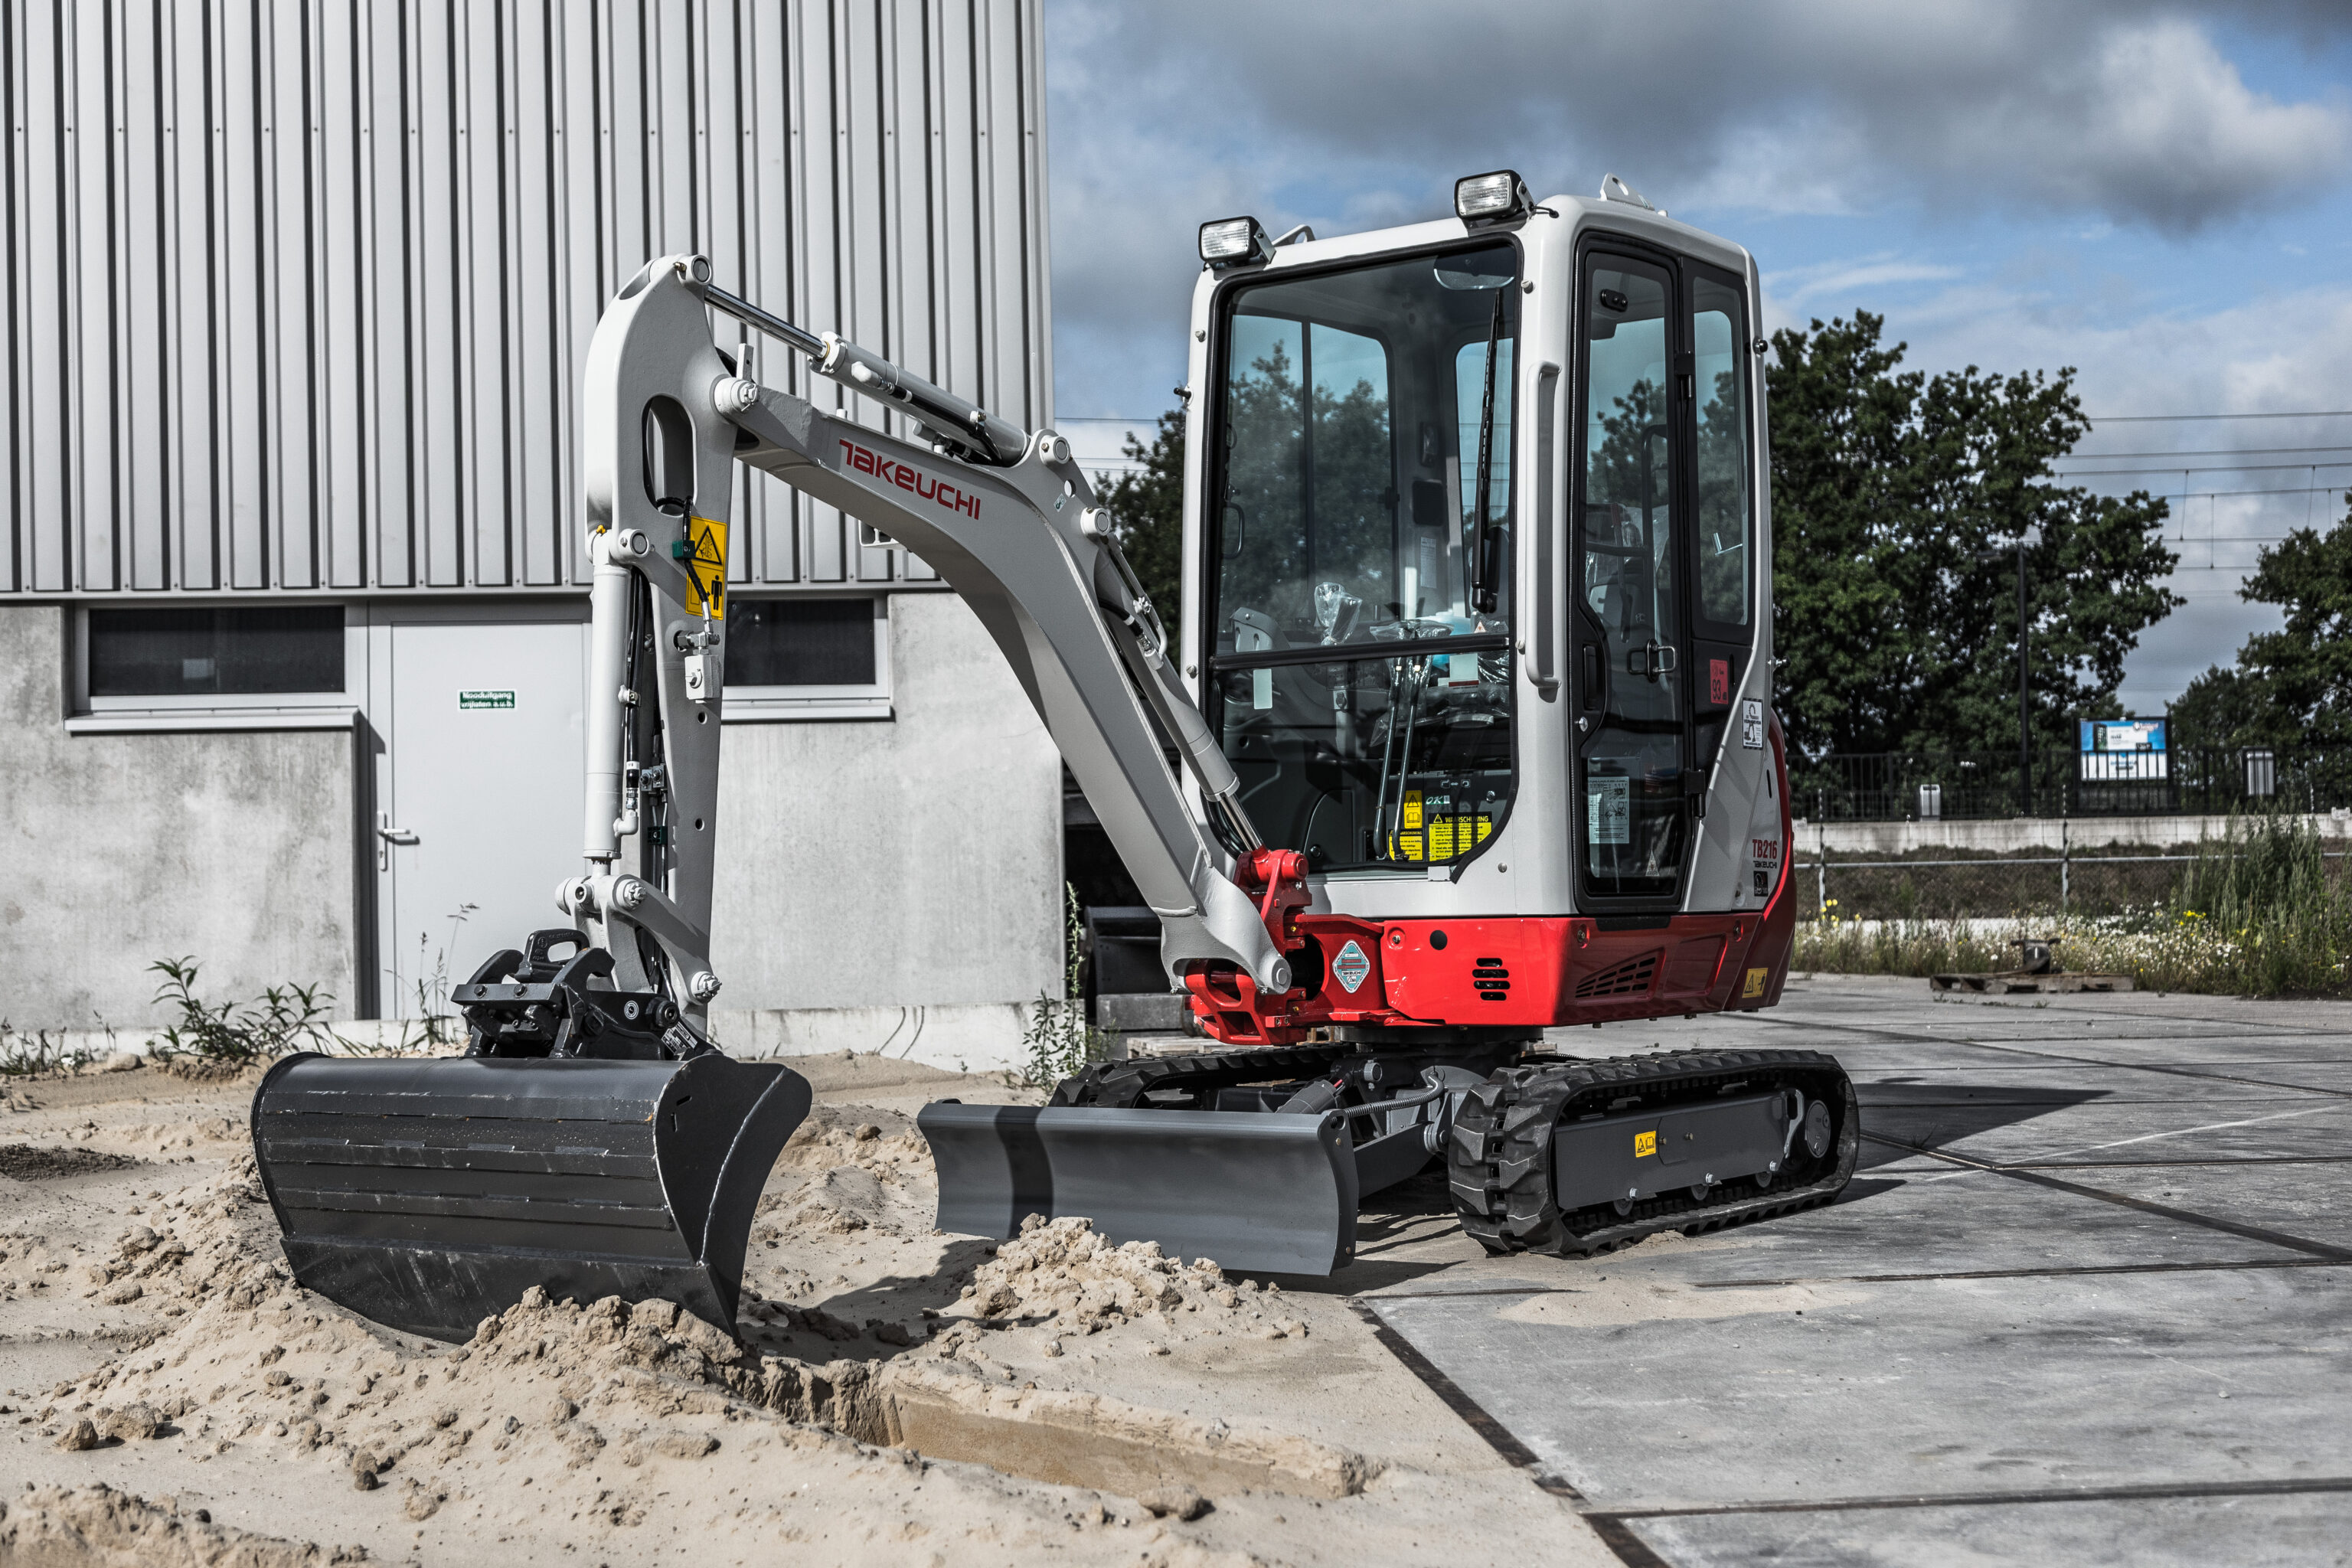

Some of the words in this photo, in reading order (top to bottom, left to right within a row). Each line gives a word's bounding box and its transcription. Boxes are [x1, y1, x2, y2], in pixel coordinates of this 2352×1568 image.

[839, 439, 981, 521] TAKEUCHI
[462, 691, 512, 700] Nooduitgang
[1712, 678, 1722, 700] 93
[1426, 795, 1443, 805] OK
[1753, 838, 1777, 859] TB216
[1753, 860, 1777, 869] TAKEUCHI
